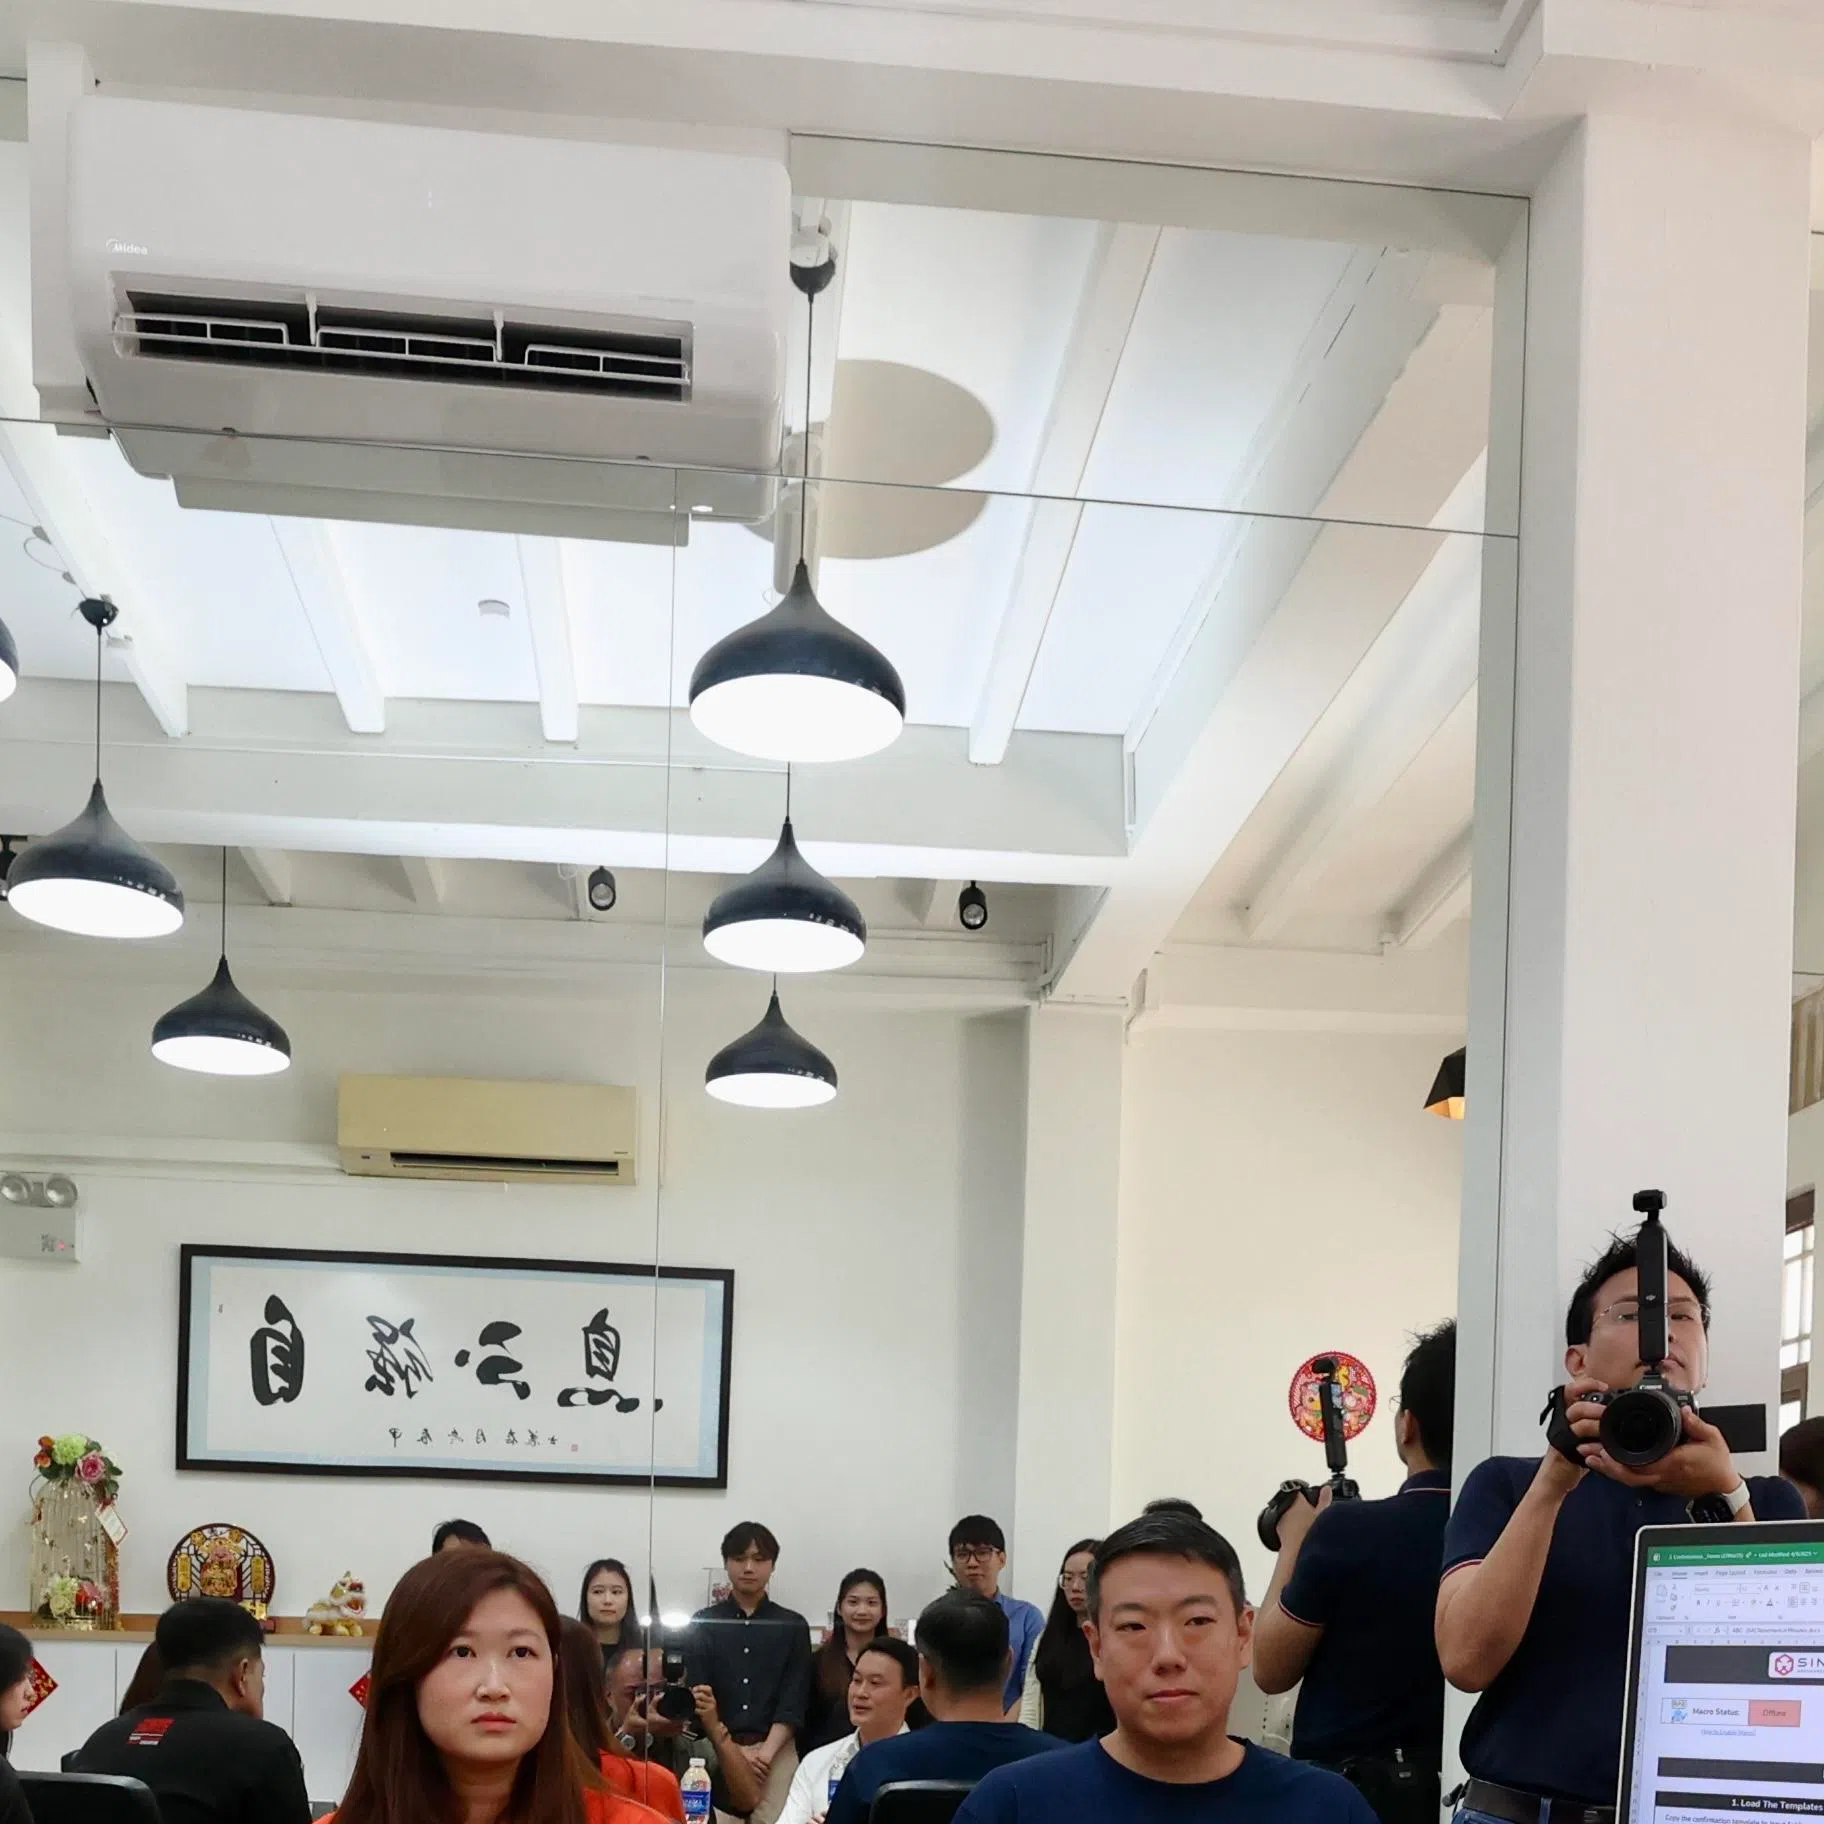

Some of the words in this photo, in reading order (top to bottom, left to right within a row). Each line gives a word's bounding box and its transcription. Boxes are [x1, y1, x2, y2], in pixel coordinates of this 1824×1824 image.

[1692, 1708, 1714, 1716] Macro
[1762, 1709, 1786, 1717] Offline
[1732, 1799, 1739, 1807] 1.
[1741, 1800, 1760, 1808] Load
[1763, 1800, 1778, 1809] The
[1780, 1801, 1823, 1811] Templates
[1665, 1814, 1679, 1822] Copy
[1692, 1816, 1731, 1824] confirmation
